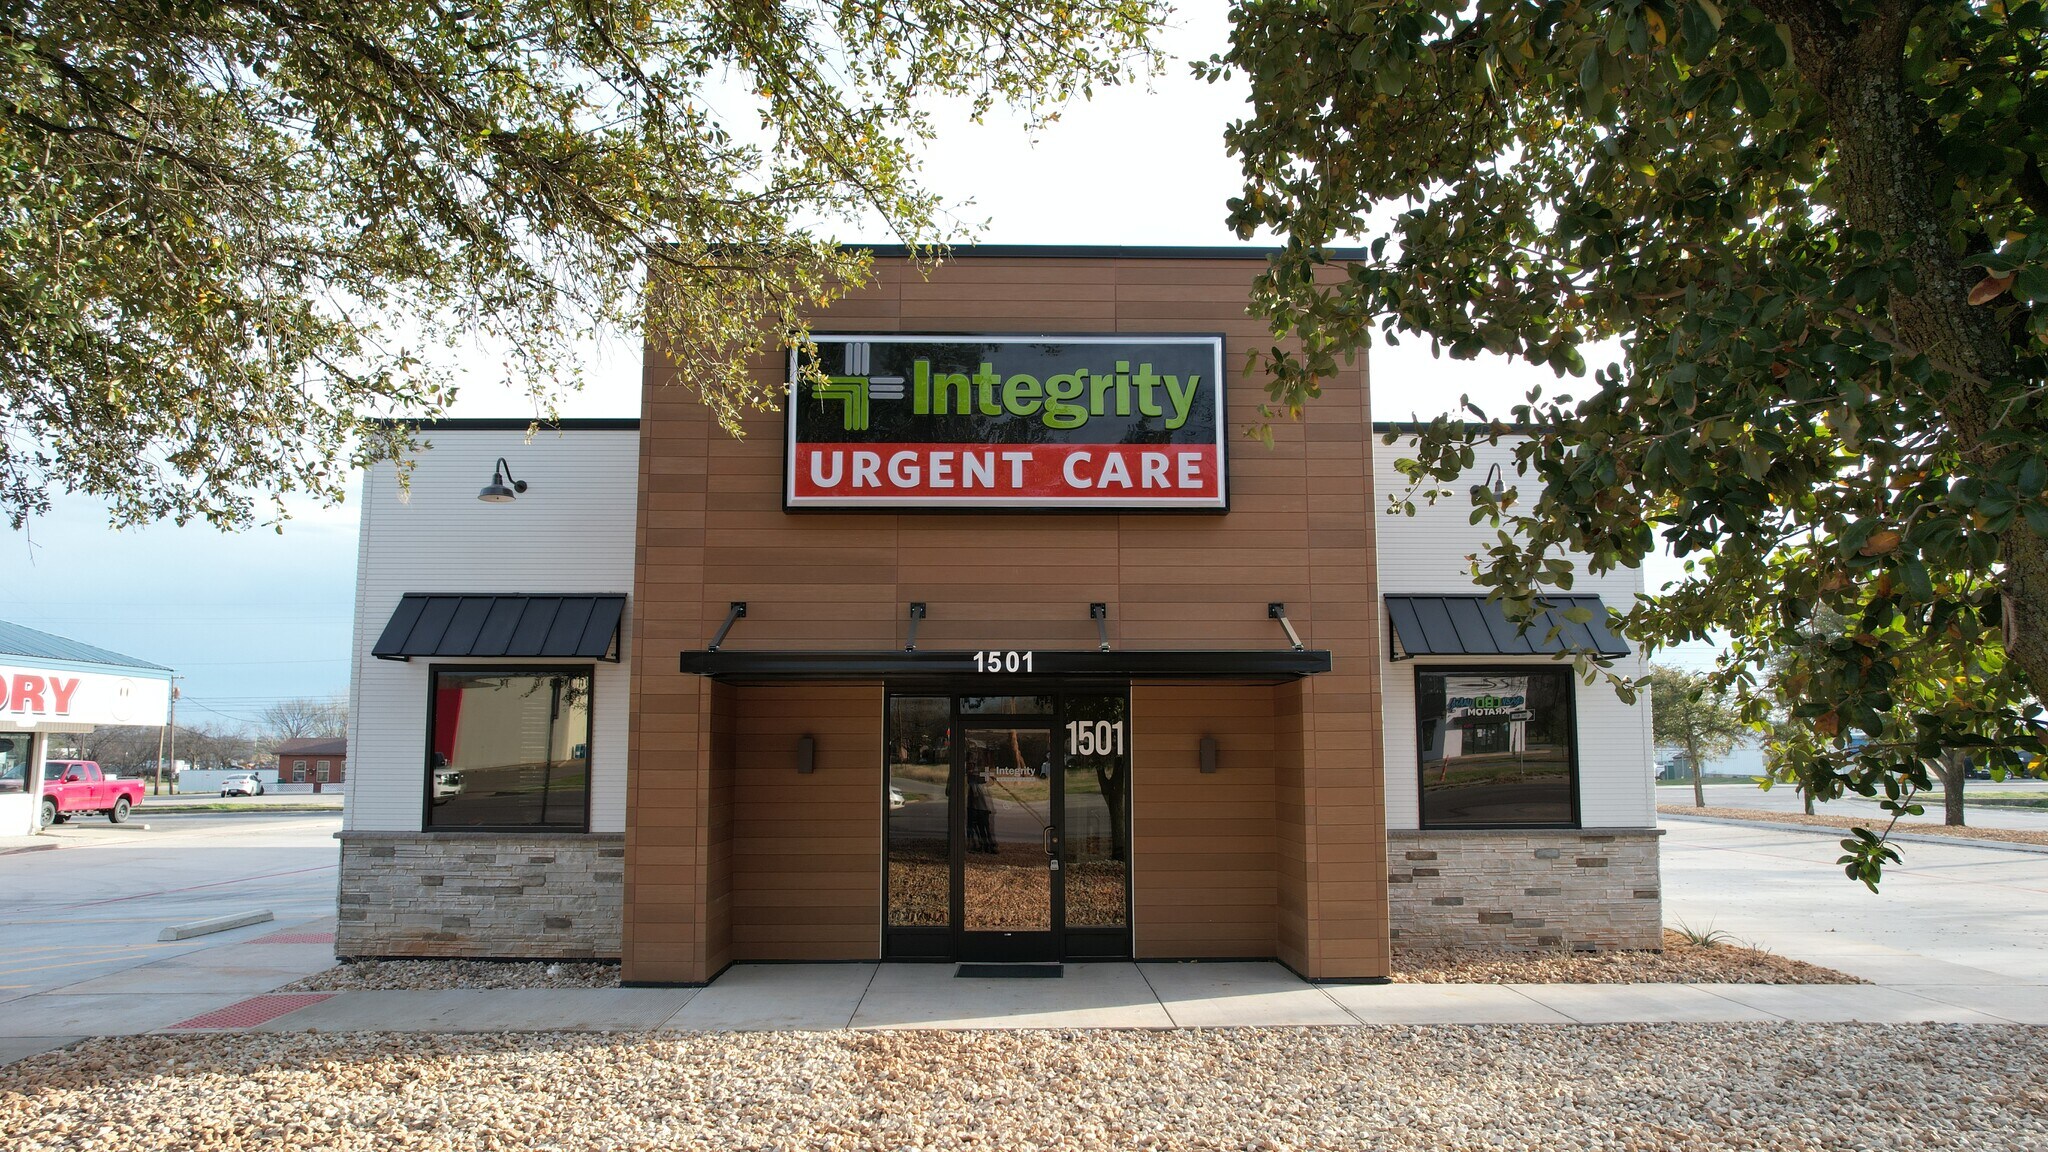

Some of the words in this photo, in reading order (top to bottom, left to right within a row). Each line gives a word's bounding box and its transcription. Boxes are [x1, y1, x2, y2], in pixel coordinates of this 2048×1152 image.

[913, 360, 1200, 430] Integrity
[810, 450, 1034, 490] URGENT
[1063, 451, 1204, 490] CARE
[973, 651, 1033, 673] 1501
[1065, 720, 1124, 756] 1501
[996, 766, 1036, 776] Integrity
